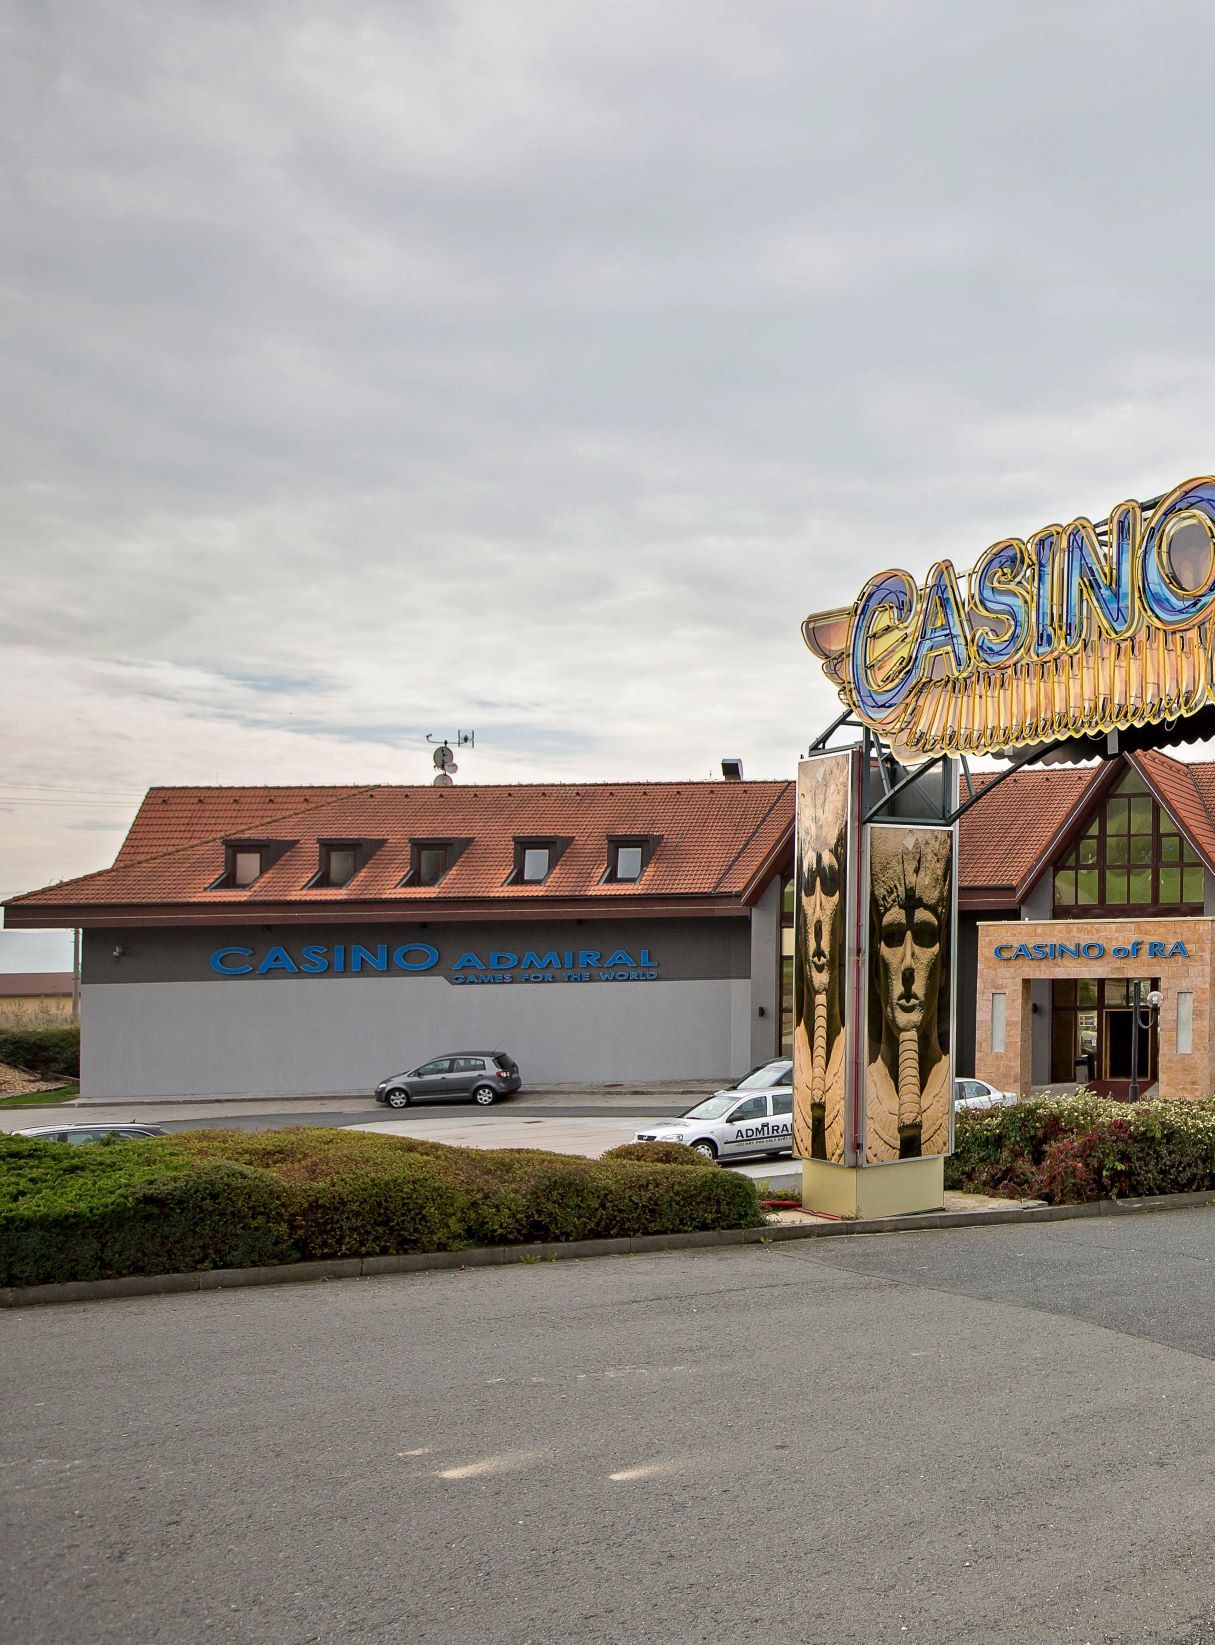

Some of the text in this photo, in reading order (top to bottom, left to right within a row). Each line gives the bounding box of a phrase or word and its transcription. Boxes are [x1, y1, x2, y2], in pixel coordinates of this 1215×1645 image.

[210, 943, 658, 974] CASINO ADMIRAL
[993, 940, 1189, 960] CASINO of RA
[451, 971, 658, 984] GAMES FOR THE WORLD
